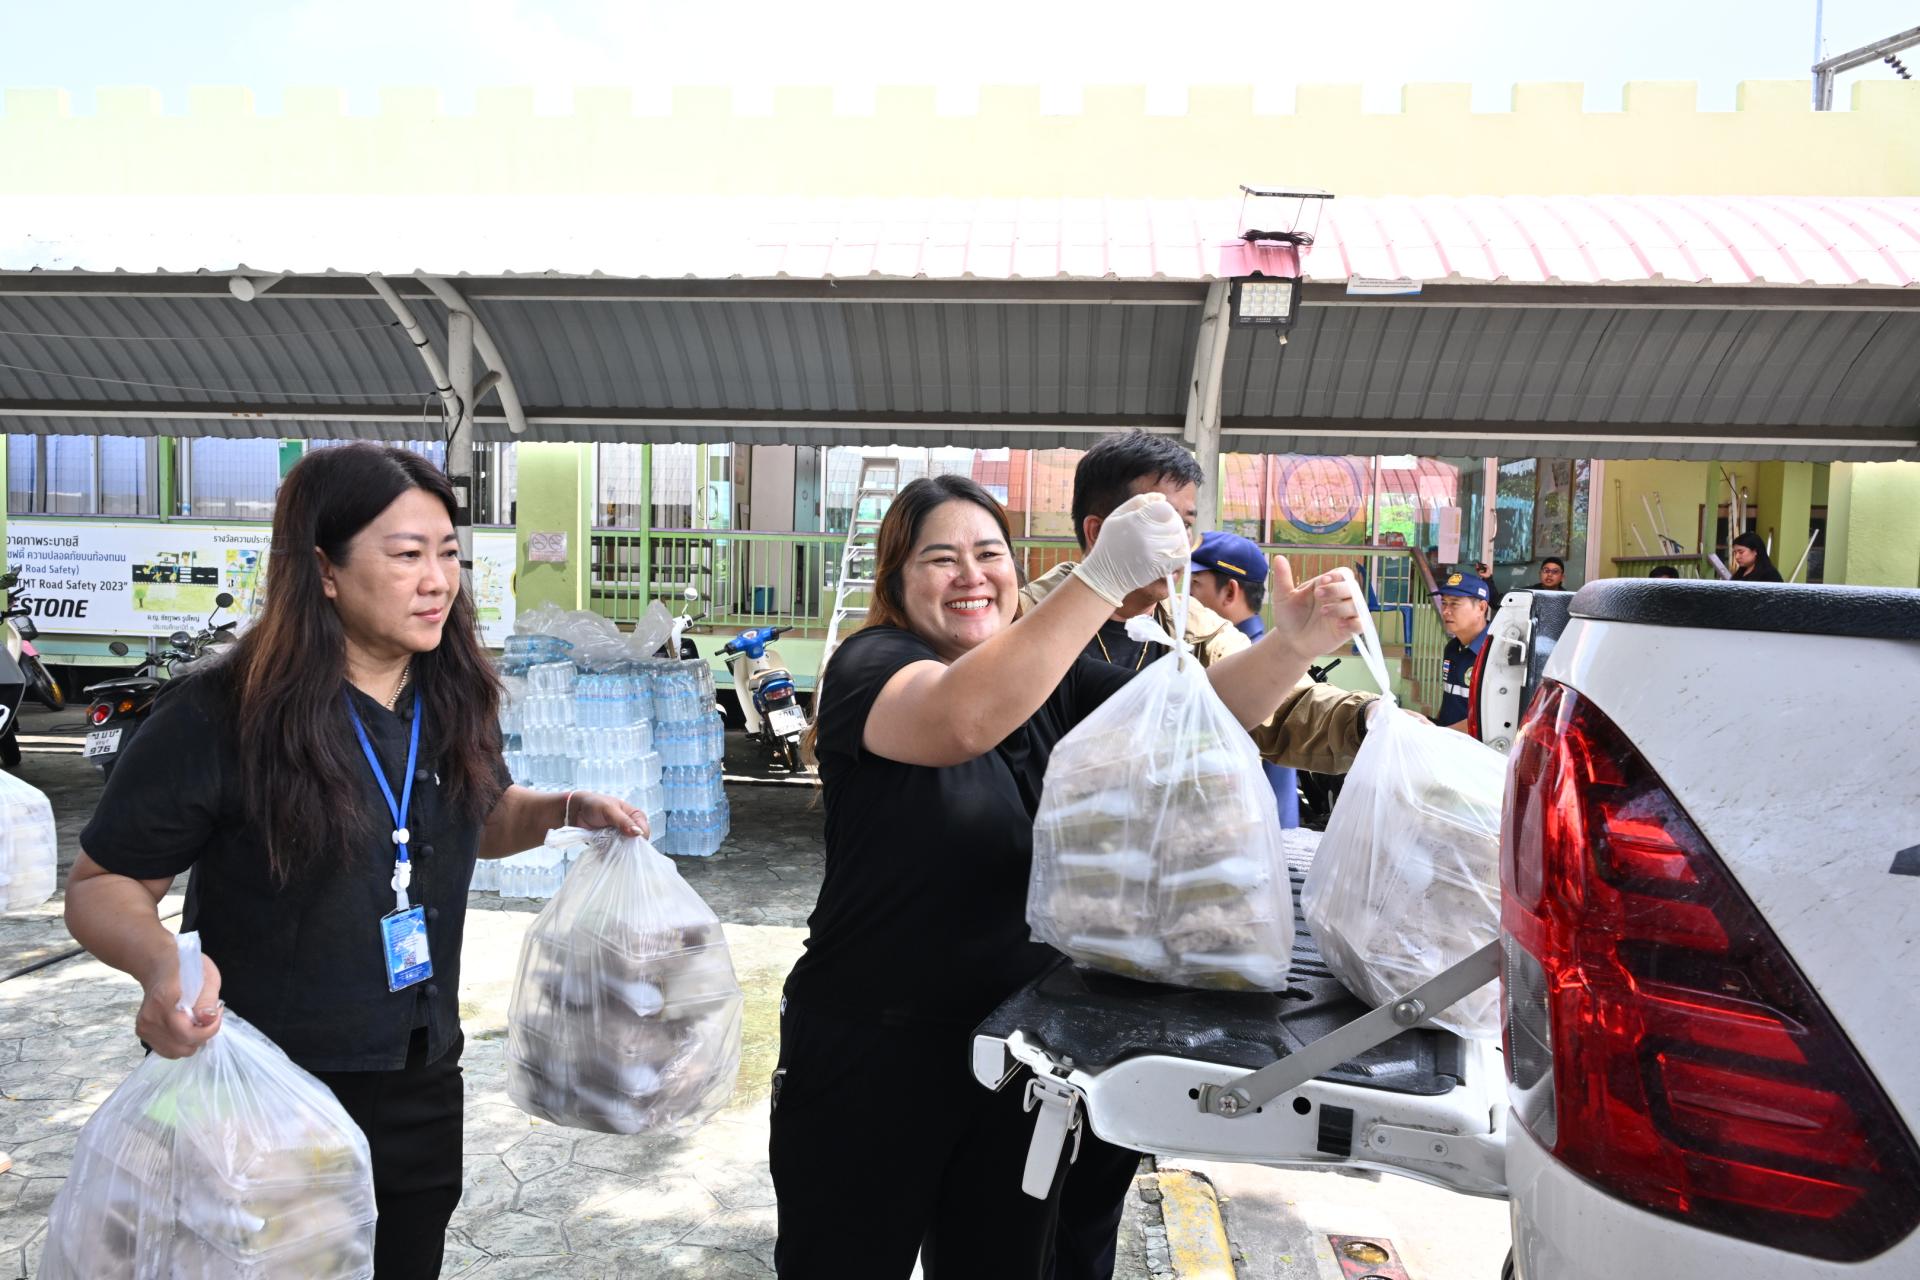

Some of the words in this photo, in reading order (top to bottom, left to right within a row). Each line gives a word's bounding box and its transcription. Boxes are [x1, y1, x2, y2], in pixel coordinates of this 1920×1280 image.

[25, 564, 47, 573] Road
[49, 565, 80, 576] Safety)
[39, 579, 63, 589] Road
[66, 580, 97, 592] Safety
